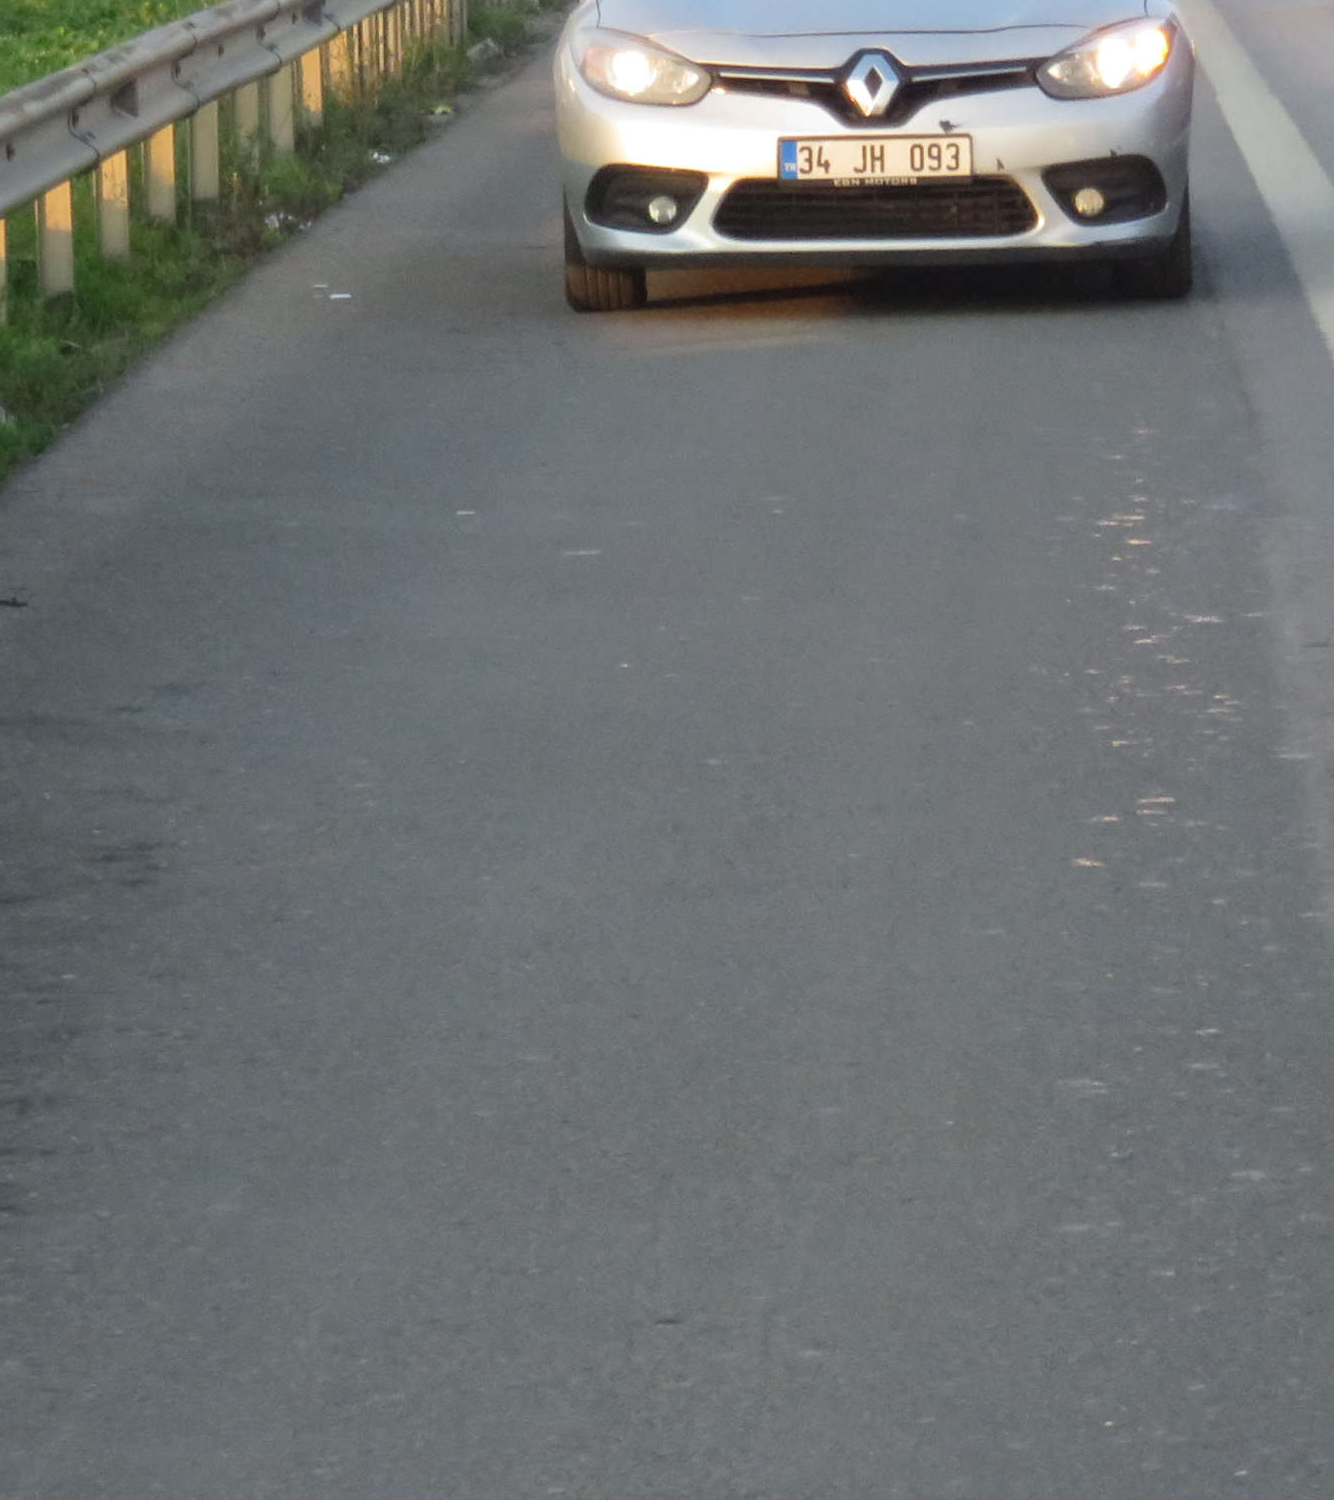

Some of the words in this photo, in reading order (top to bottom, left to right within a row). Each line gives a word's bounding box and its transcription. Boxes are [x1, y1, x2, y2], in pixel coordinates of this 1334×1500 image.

[799, 145, 831, 174] 34
[853, 144, 885, 173] JH
[909, 142, 960, 172] 093
